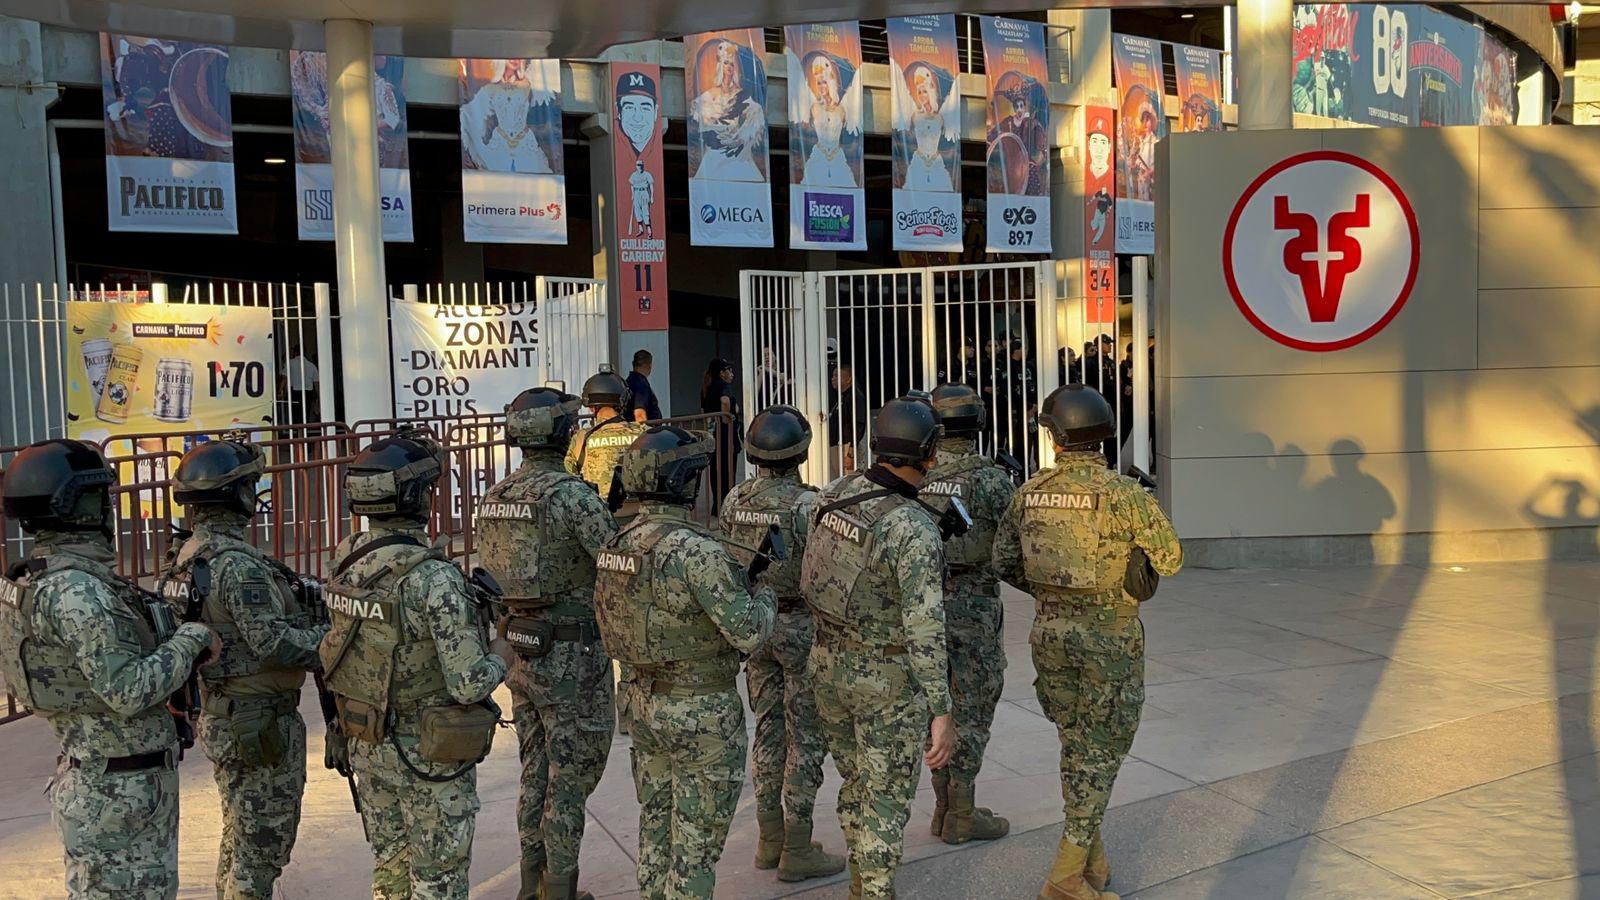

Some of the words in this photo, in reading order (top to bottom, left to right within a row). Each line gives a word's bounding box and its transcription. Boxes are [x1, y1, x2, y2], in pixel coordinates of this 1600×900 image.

[1373, 4, 1408, 98] 80
[120, 176, 224, 216] PACIFICO
[468, 204, 516, 216] Primera
[519, 206, 545, 217] Plus
[718, 207, 764, 223] MEGA
[809, 201, 843, 218] FRESCA
[1133, 220, 1154, 232] HERS
[1008, 230, 1033, 246] 89.7
[621, 251, 665, 262] GARIBAY
[634, 264, 652, 291] 11
[1090, 270, 1111, 291] 34
[136, 326, 168, 334] CARNAVAL
[174, 325, 205, 336] PACIFICO
[446, 319, 538, 346] ZONAS
[918, 481, 962, 497] ARINA
[1025, 493, 1093, 509] MARINA
[480, 503, 532, 519] MARINA
[735, 510, 781, 525] MARINA
[821, 512, 859, 543] ARINA
[596, 552, 635, 573] ARINA
[325, 590, 385, 620] MARINA
[506, 630, 541, 646] MARINA
